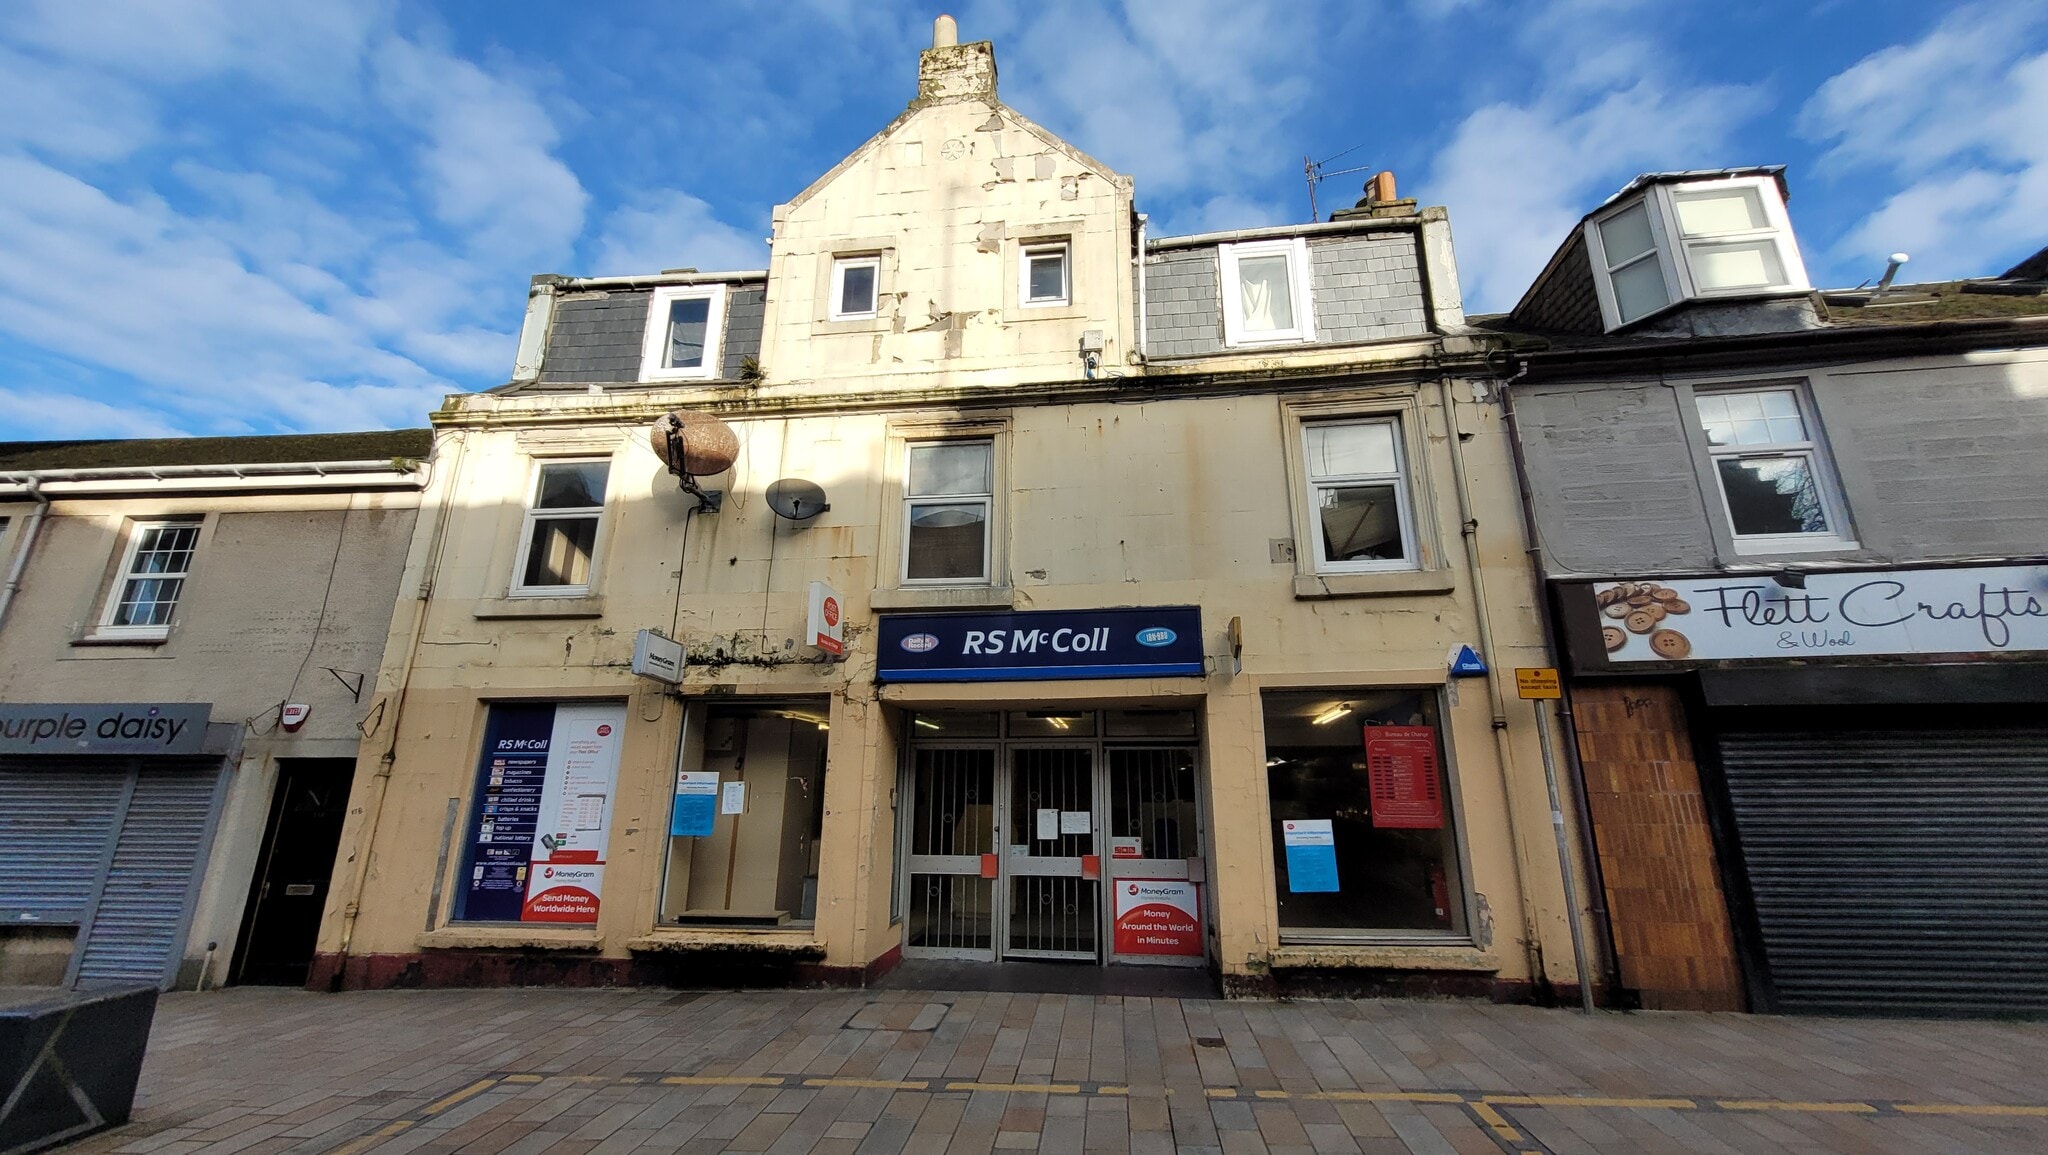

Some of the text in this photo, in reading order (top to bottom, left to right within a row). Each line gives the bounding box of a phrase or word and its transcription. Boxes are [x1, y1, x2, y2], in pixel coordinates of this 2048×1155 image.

[827, 601, 837, 612] POST
[825, 609, 838, 622] OFFICE
[1693, 582, 2048, 647] Flett Crafts
[962, 627, 1109, 655] RS McColl
[1777, 630, 1855, 649] & Wool
[0, 707, 187, 745] urple daisy
[497, 739, 549, 749] RS McColl
[555, 871, 595, 879] MoneyGram
[1140, 887, 1184, 896] MoneyGram
[542, 894, 590, 904] Send Money
[533, 905, 596, 913] Worldwide Here
[1143, 909, 1171, 919] Money
[1121, 923, 1194, 932] Around the World
[1136, 936, 1179, 945] in Minutes
